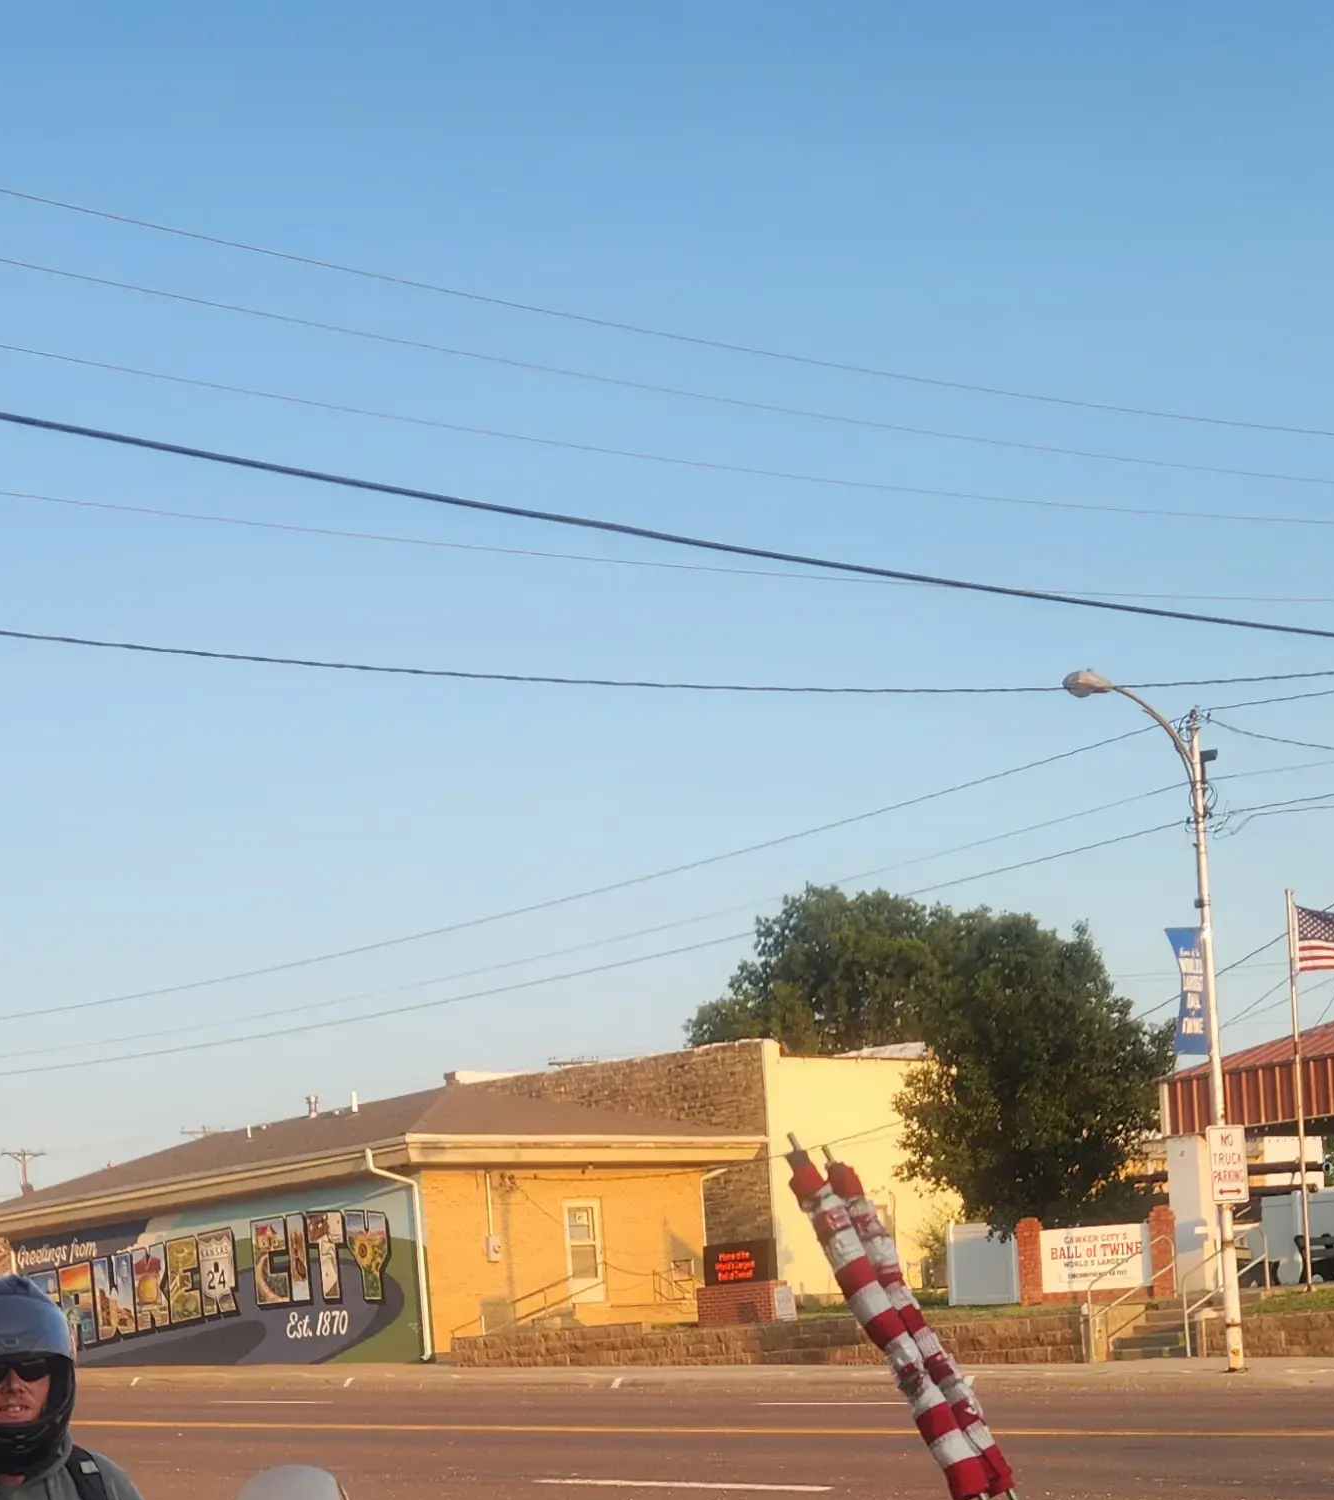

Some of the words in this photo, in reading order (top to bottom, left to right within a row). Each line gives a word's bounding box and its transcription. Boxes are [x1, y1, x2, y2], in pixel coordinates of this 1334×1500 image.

[1220, 1132, 1234, 1147] NO
[1213, 1152, 1243, 1165] TRUCK
[18, 1244, 68, 1270] Greetings
[69, 1237, 98, 1264] from
[250, 1209, 392, 1309] CITY
[1050, 1245, 1082, 1260] BALL
[1086, 1243, 1097, 1258] of
[1100, 1241, 1143, 1257] TWINE
[206, 1272, 228, 1291] 24
[286, 1310, 314, 1340] Est.
[315, 1310, 349, 1337] 1870
